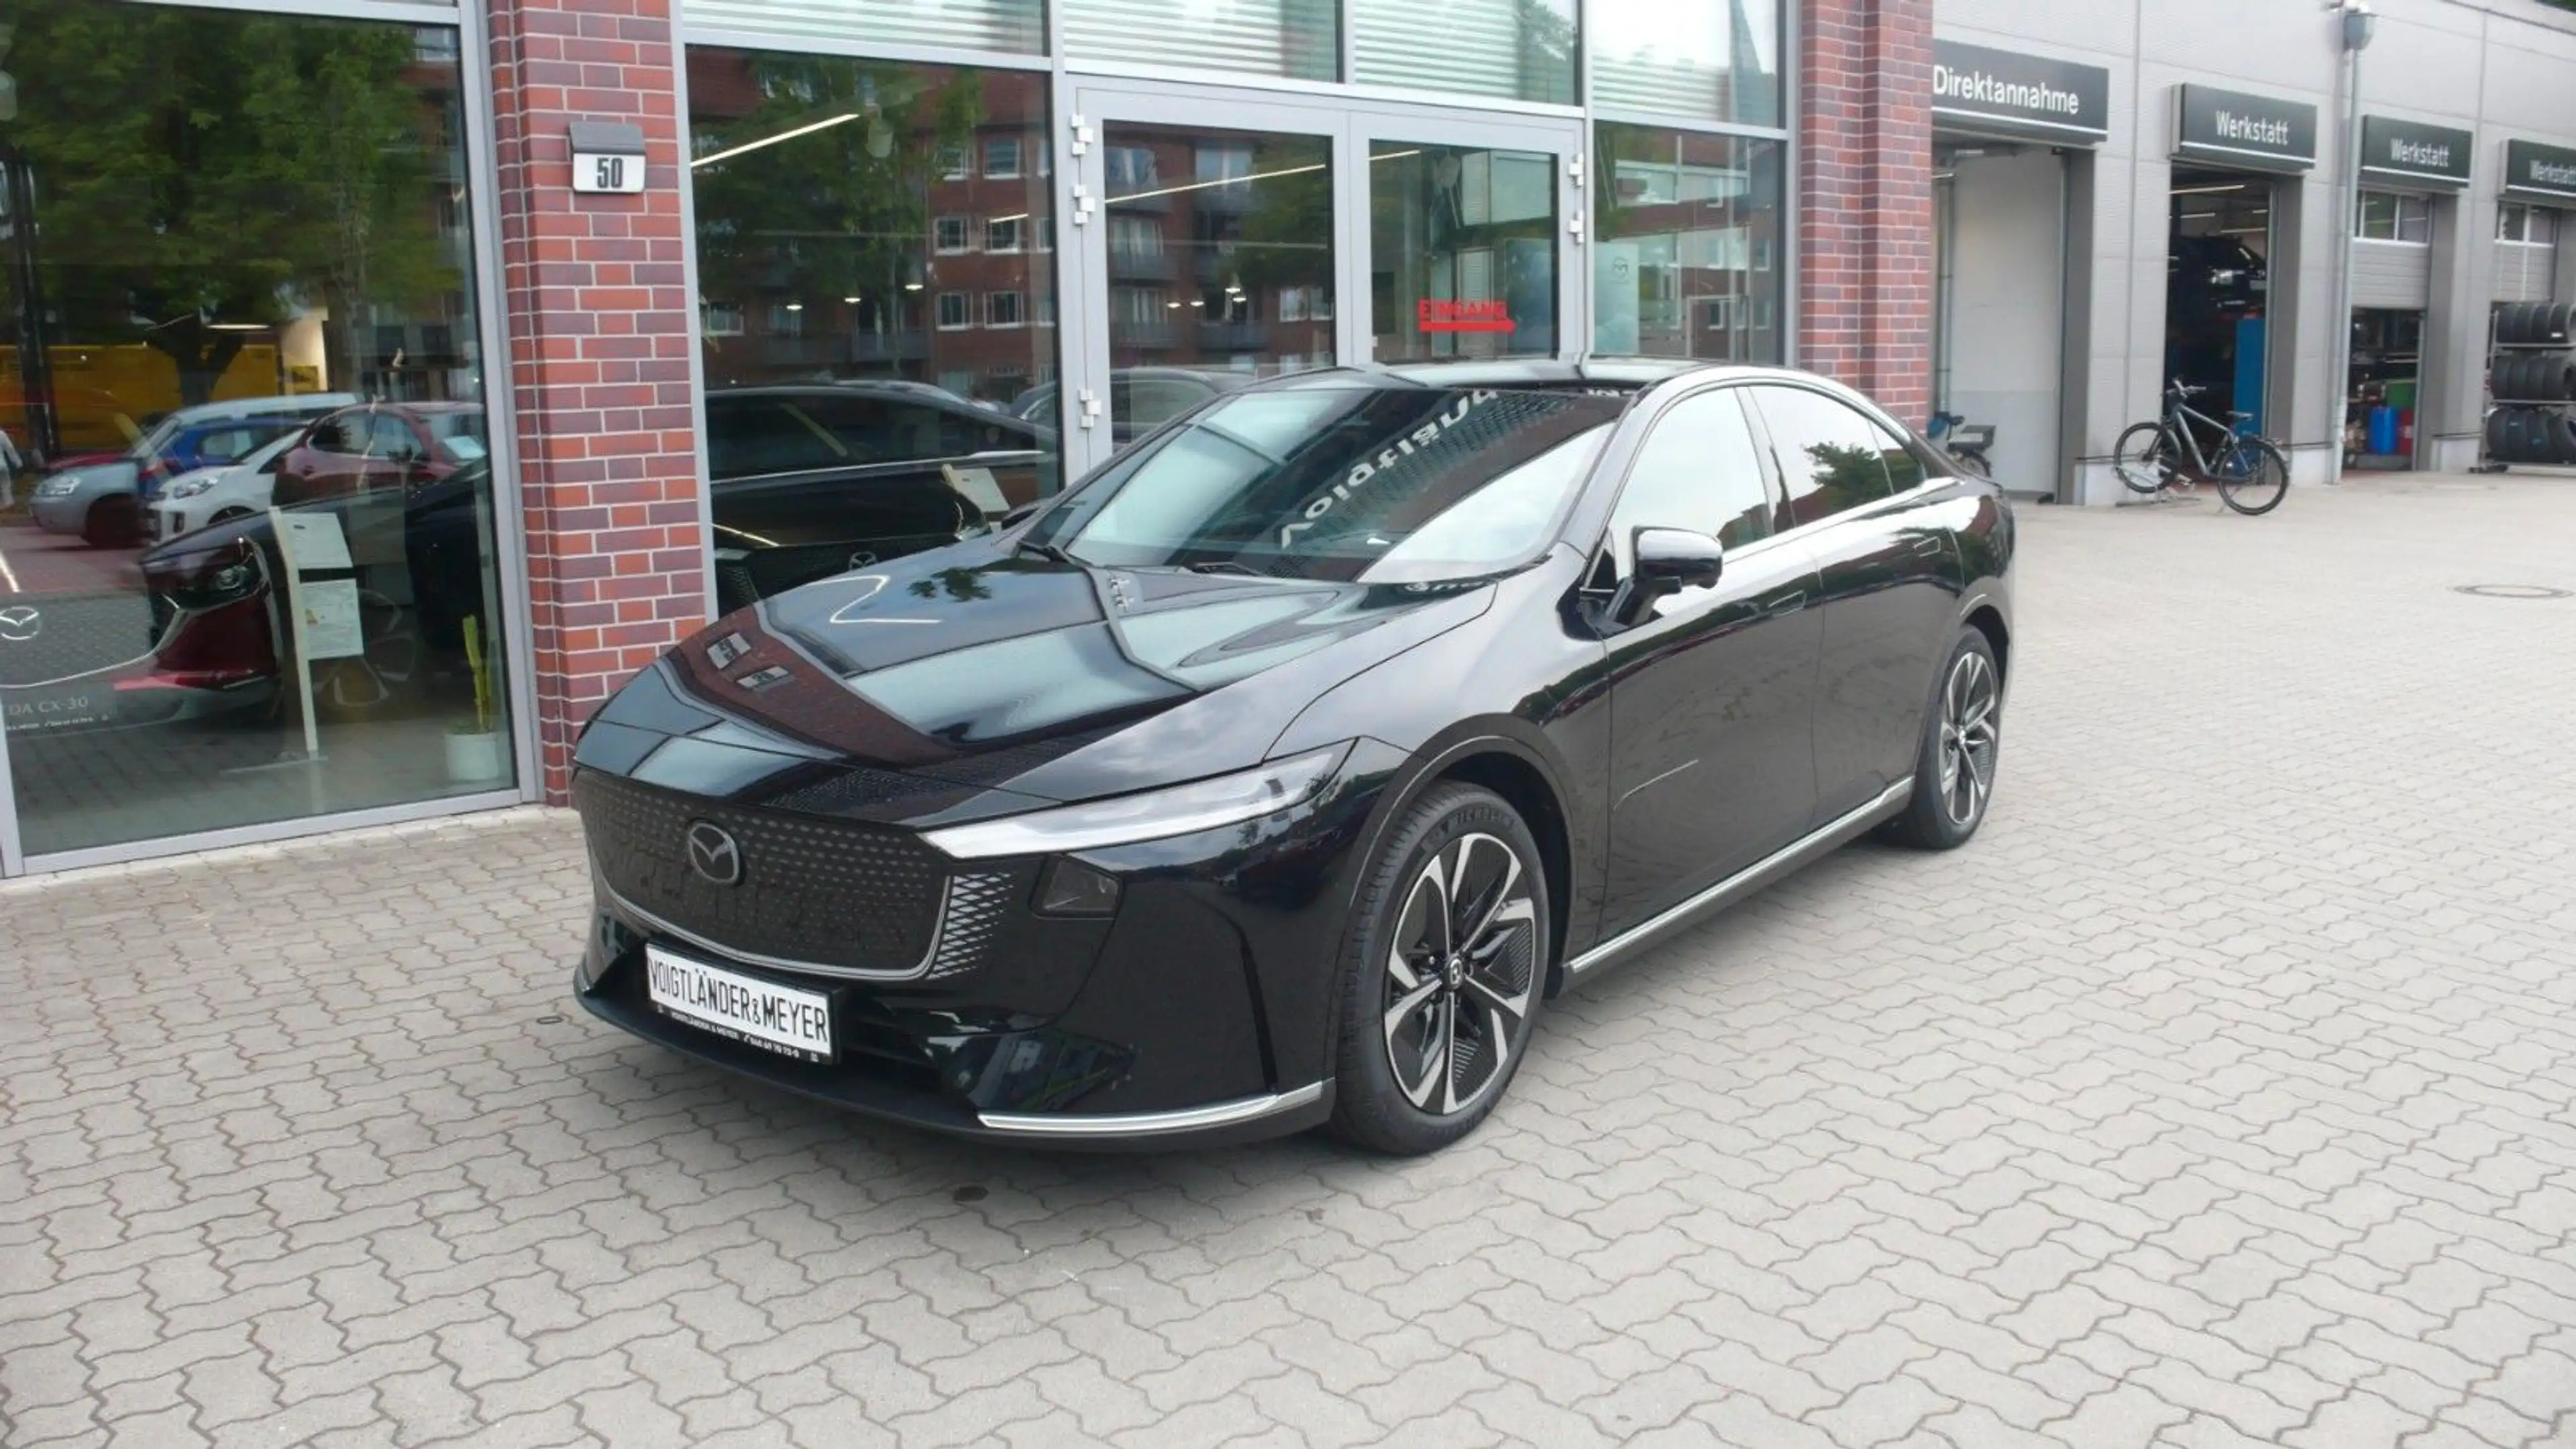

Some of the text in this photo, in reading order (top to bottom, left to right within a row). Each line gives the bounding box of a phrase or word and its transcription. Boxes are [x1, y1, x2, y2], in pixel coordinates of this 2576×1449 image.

[1933, 64, 2079, 114] Direktannahme
[2216, 109, 2288, 146] Werkstatt
[2391, 138, 2449, 167] Werkstatt
[597, 157, 623, 189] 50
[38, 696, 89, 712] CX-30
